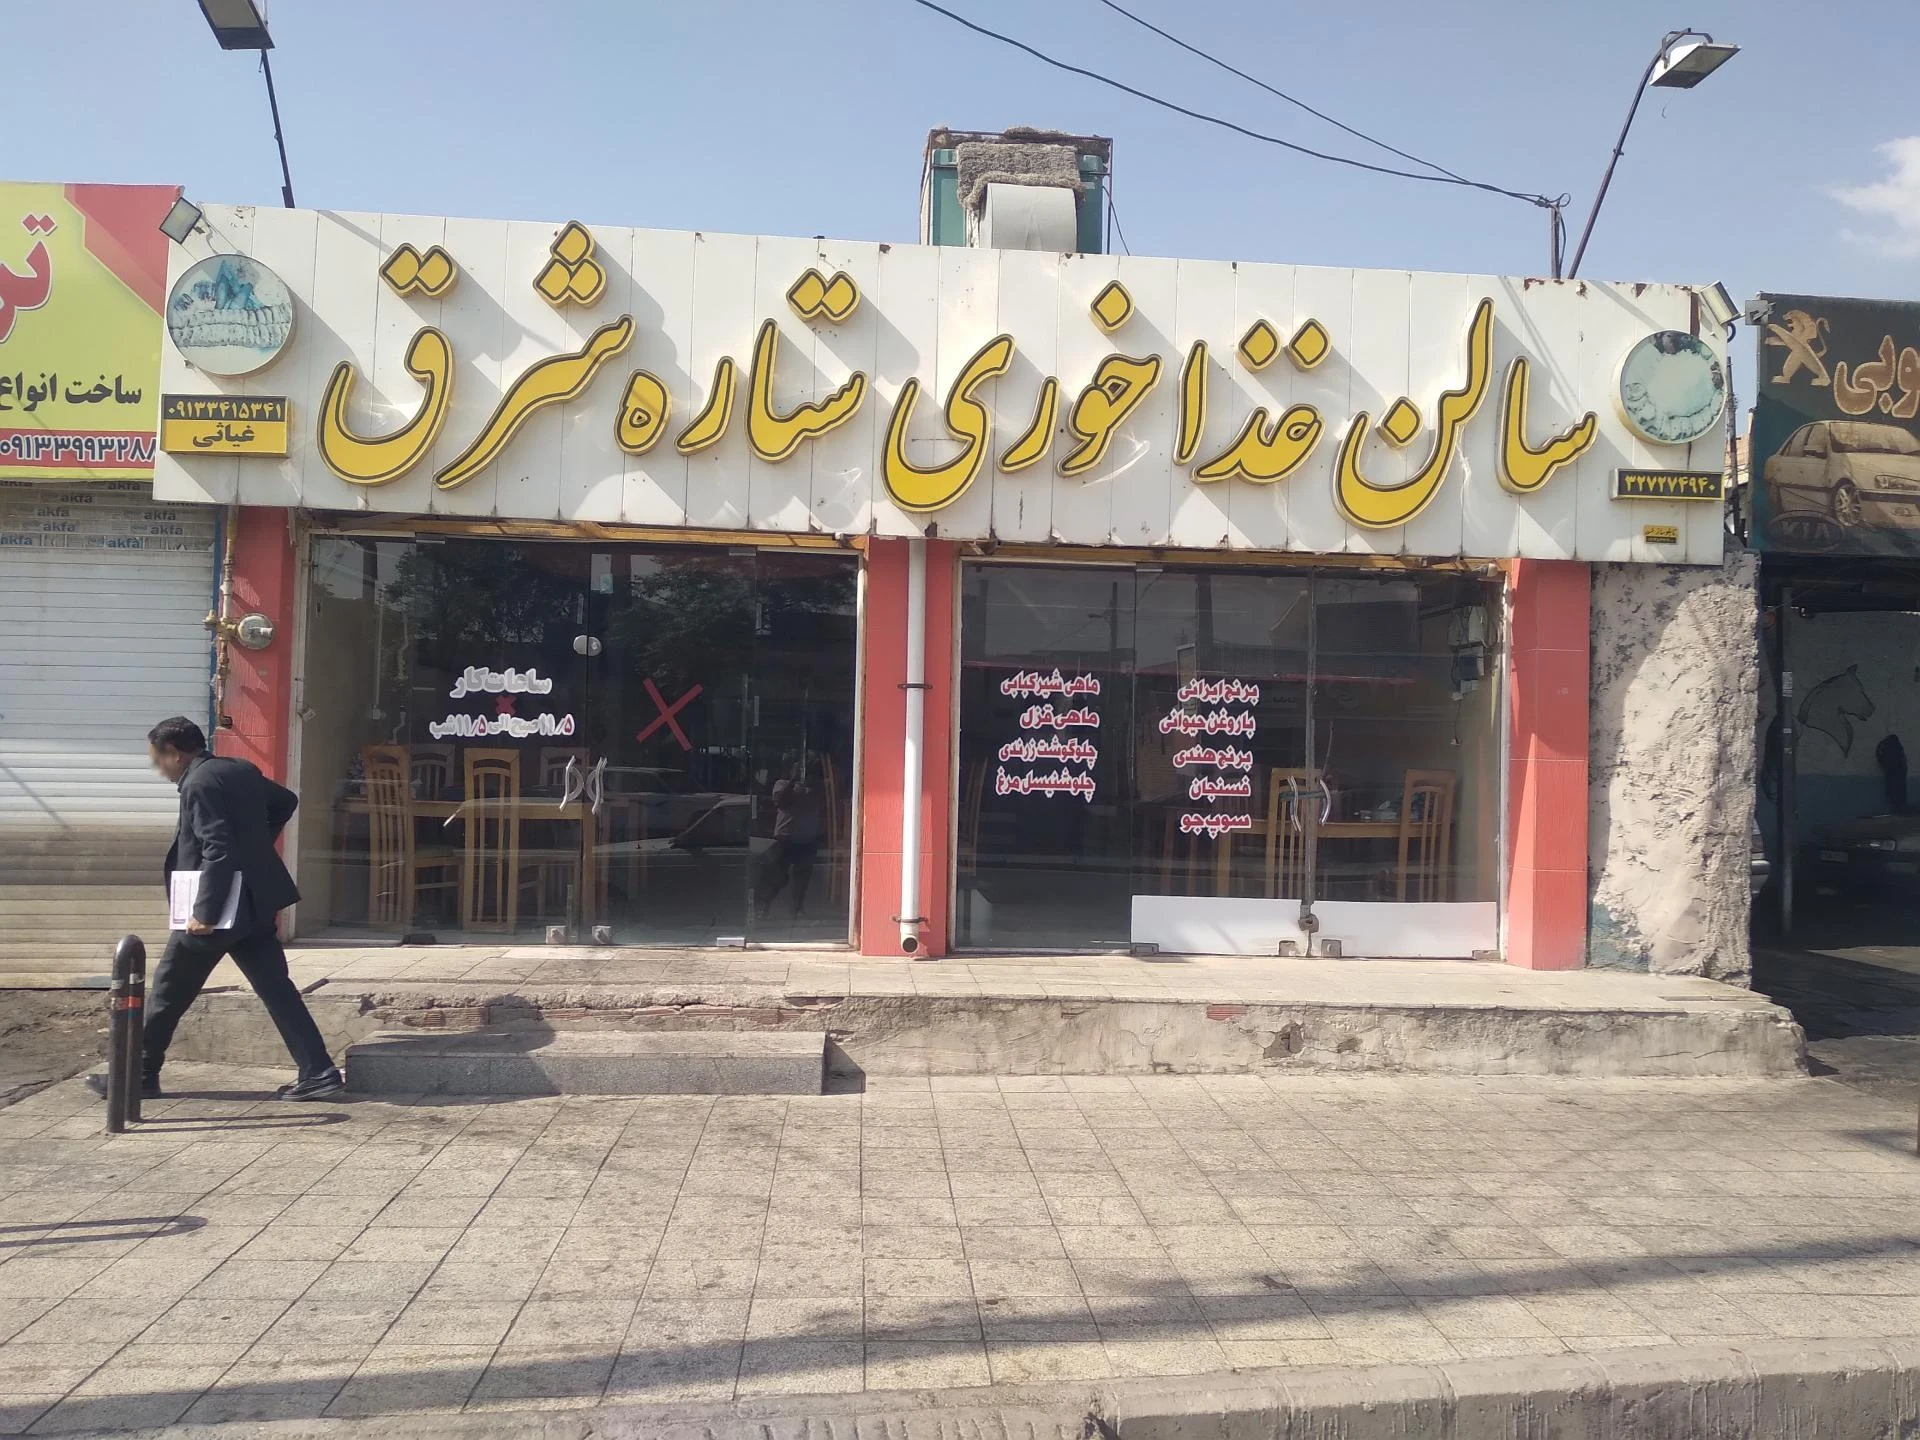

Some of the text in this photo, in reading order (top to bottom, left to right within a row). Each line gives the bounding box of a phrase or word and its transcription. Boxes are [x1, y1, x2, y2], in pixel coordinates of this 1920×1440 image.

[318, 219, 636, 490] شرق
[614, 269, 868, 464] ستاره
[65, 374, 142, 404] ساخت
[168, 400, 281, 419] ۰۹۱۳۳۴۱۵۳۴۱
[1333, 296, 1599, 530] سالن
[192, 422, 255, 447] غیاثی
[37, 506, 70, 517] akfa
[144, 510, 177, 521] akfa
[43, 521, 76, 532] akfa
[150, 524, 184, 535] akfa
[108, 537, 141, 549] akfa
[450, 666, 552, 698] ساعات کار
[1063, 672, 1100, 697] ماهی
[1177, 678, 1259, 706] برنج ایرانی
[1020, 703, 1100, 729] ماهی قزل
[1159, 707, 1206, 737] حیوانی
[999, 736, 1037, 762] زرندی
[1173, 744, 1253, 772] برنج هندی
[996, 765, 1022, 795] مرغ
[1189, 774, 1251, 803] فسنجان
[1180, 813, 1251, 840] سوپ جو
